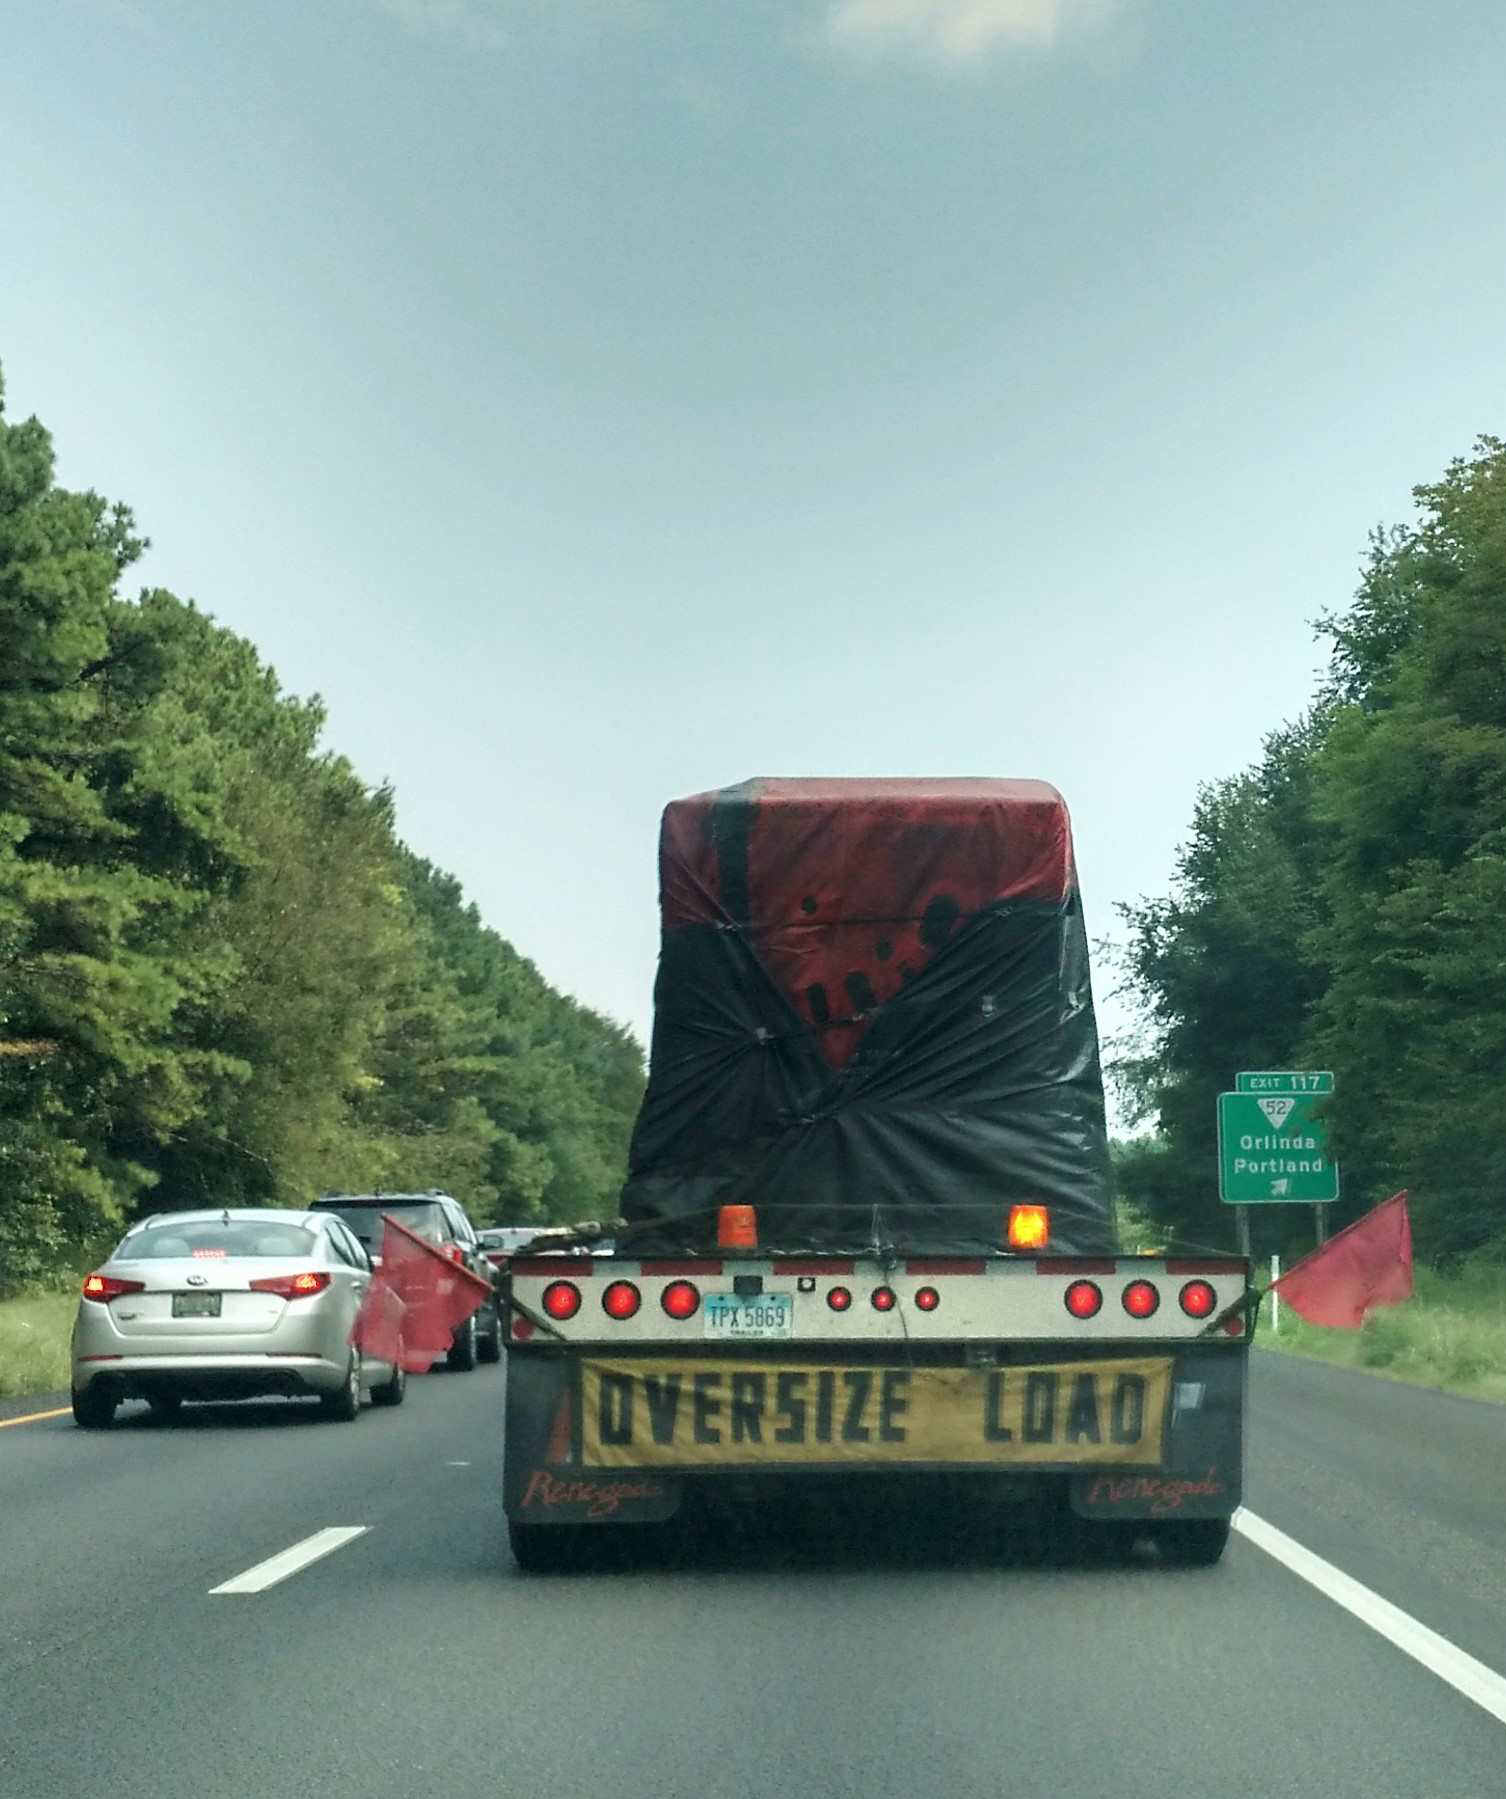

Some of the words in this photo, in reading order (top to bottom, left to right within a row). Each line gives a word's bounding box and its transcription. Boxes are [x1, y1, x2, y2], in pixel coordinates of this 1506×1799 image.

[1249, 1078, 1280, 1089] EXIT
[1290, 1076, 1320, 1090] 117
[1265, 1100, 1286, 1115] 52
[1240, 1134, 1315, 1150] Orlinda
[1233, 1157, 1322, 1174] Portland
[711, 1305, 739, 1328] TPX
[745, 1305, 785, 1328] 5869
[599, 1371, 911, 1444] OVERSIZE
[984, 1371, 1146, 1444] LOAD
